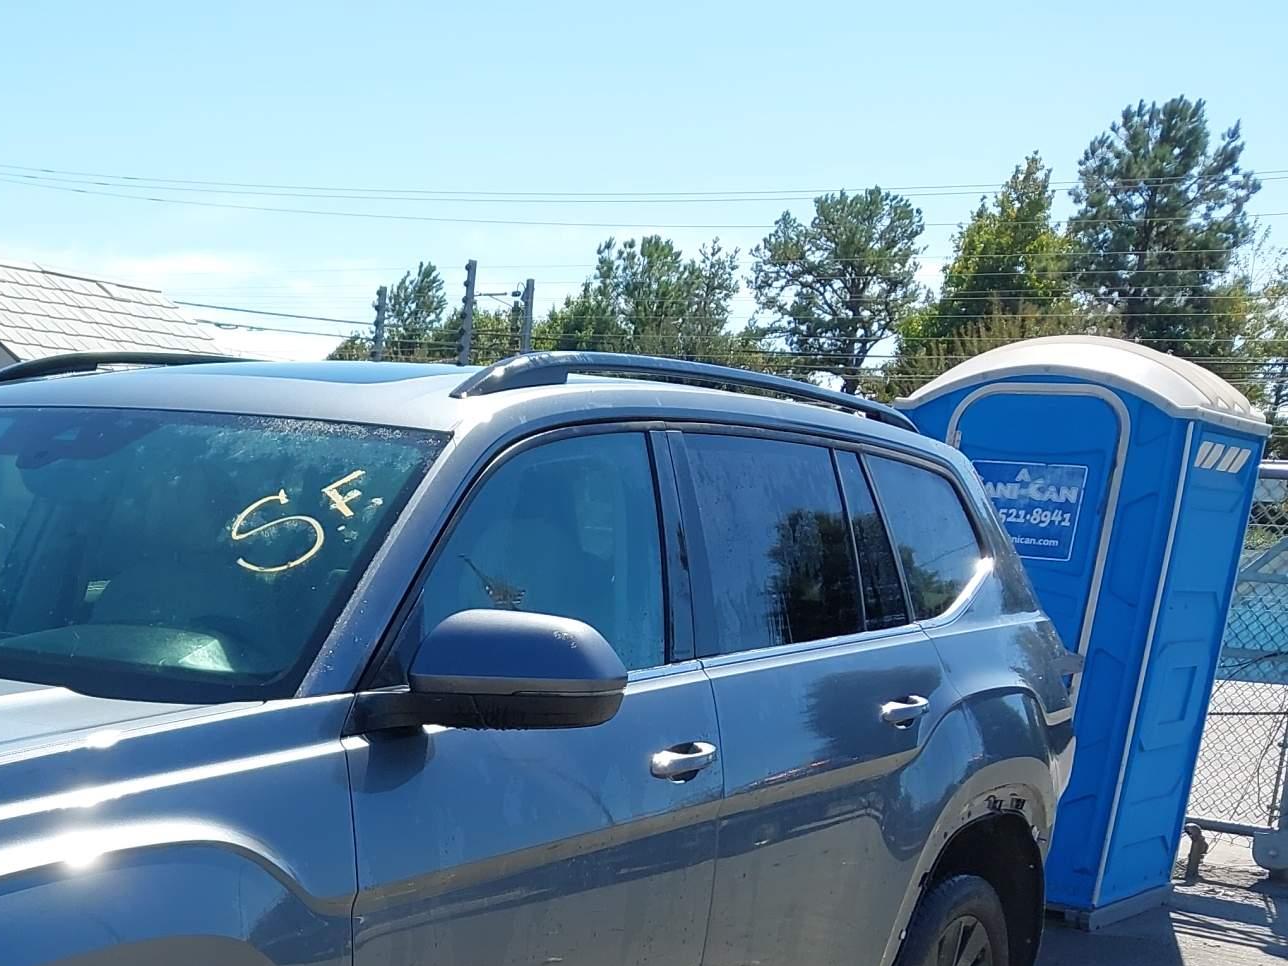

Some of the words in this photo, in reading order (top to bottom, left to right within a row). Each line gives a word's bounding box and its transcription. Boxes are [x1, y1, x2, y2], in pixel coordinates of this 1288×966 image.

[1015, 467, 1032, 482] A
[982, 480, 1079, 503] ANI-CAN
[1011, 536, 1059, 546] nican.com
